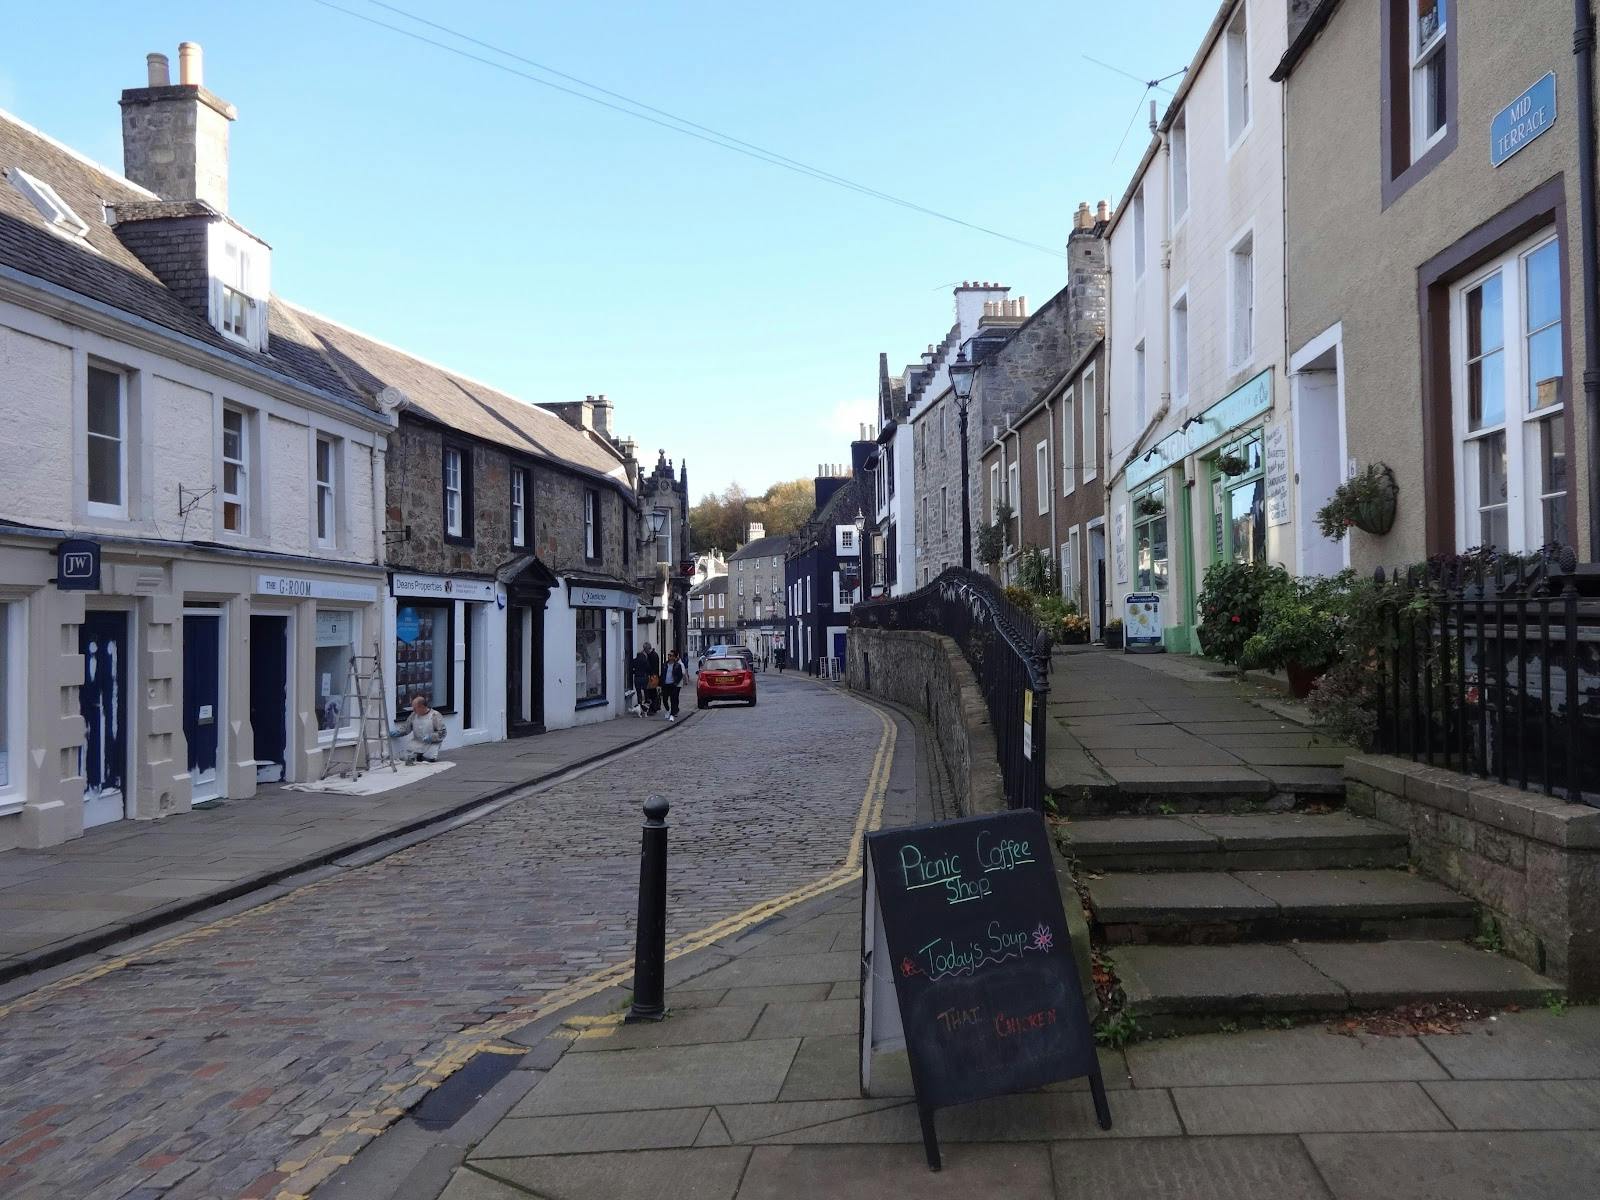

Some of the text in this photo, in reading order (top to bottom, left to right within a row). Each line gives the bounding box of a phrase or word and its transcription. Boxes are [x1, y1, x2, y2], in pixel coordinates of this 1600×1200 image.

[1509, 96, 1531, 125] MID
[1497, 106, 1546, 156] TERRACE
[67, 556, 88, 573] JW
[265, 581, 276, 590] THE
[396, 579, 415, 590] Deans
[415, 580, 443, 593] Properties
[899, 830, 1032, 888] Picnic Coffee
[945, 877, 990, 901] Shop
[918, 920, 1028, 976] Today's Soup
